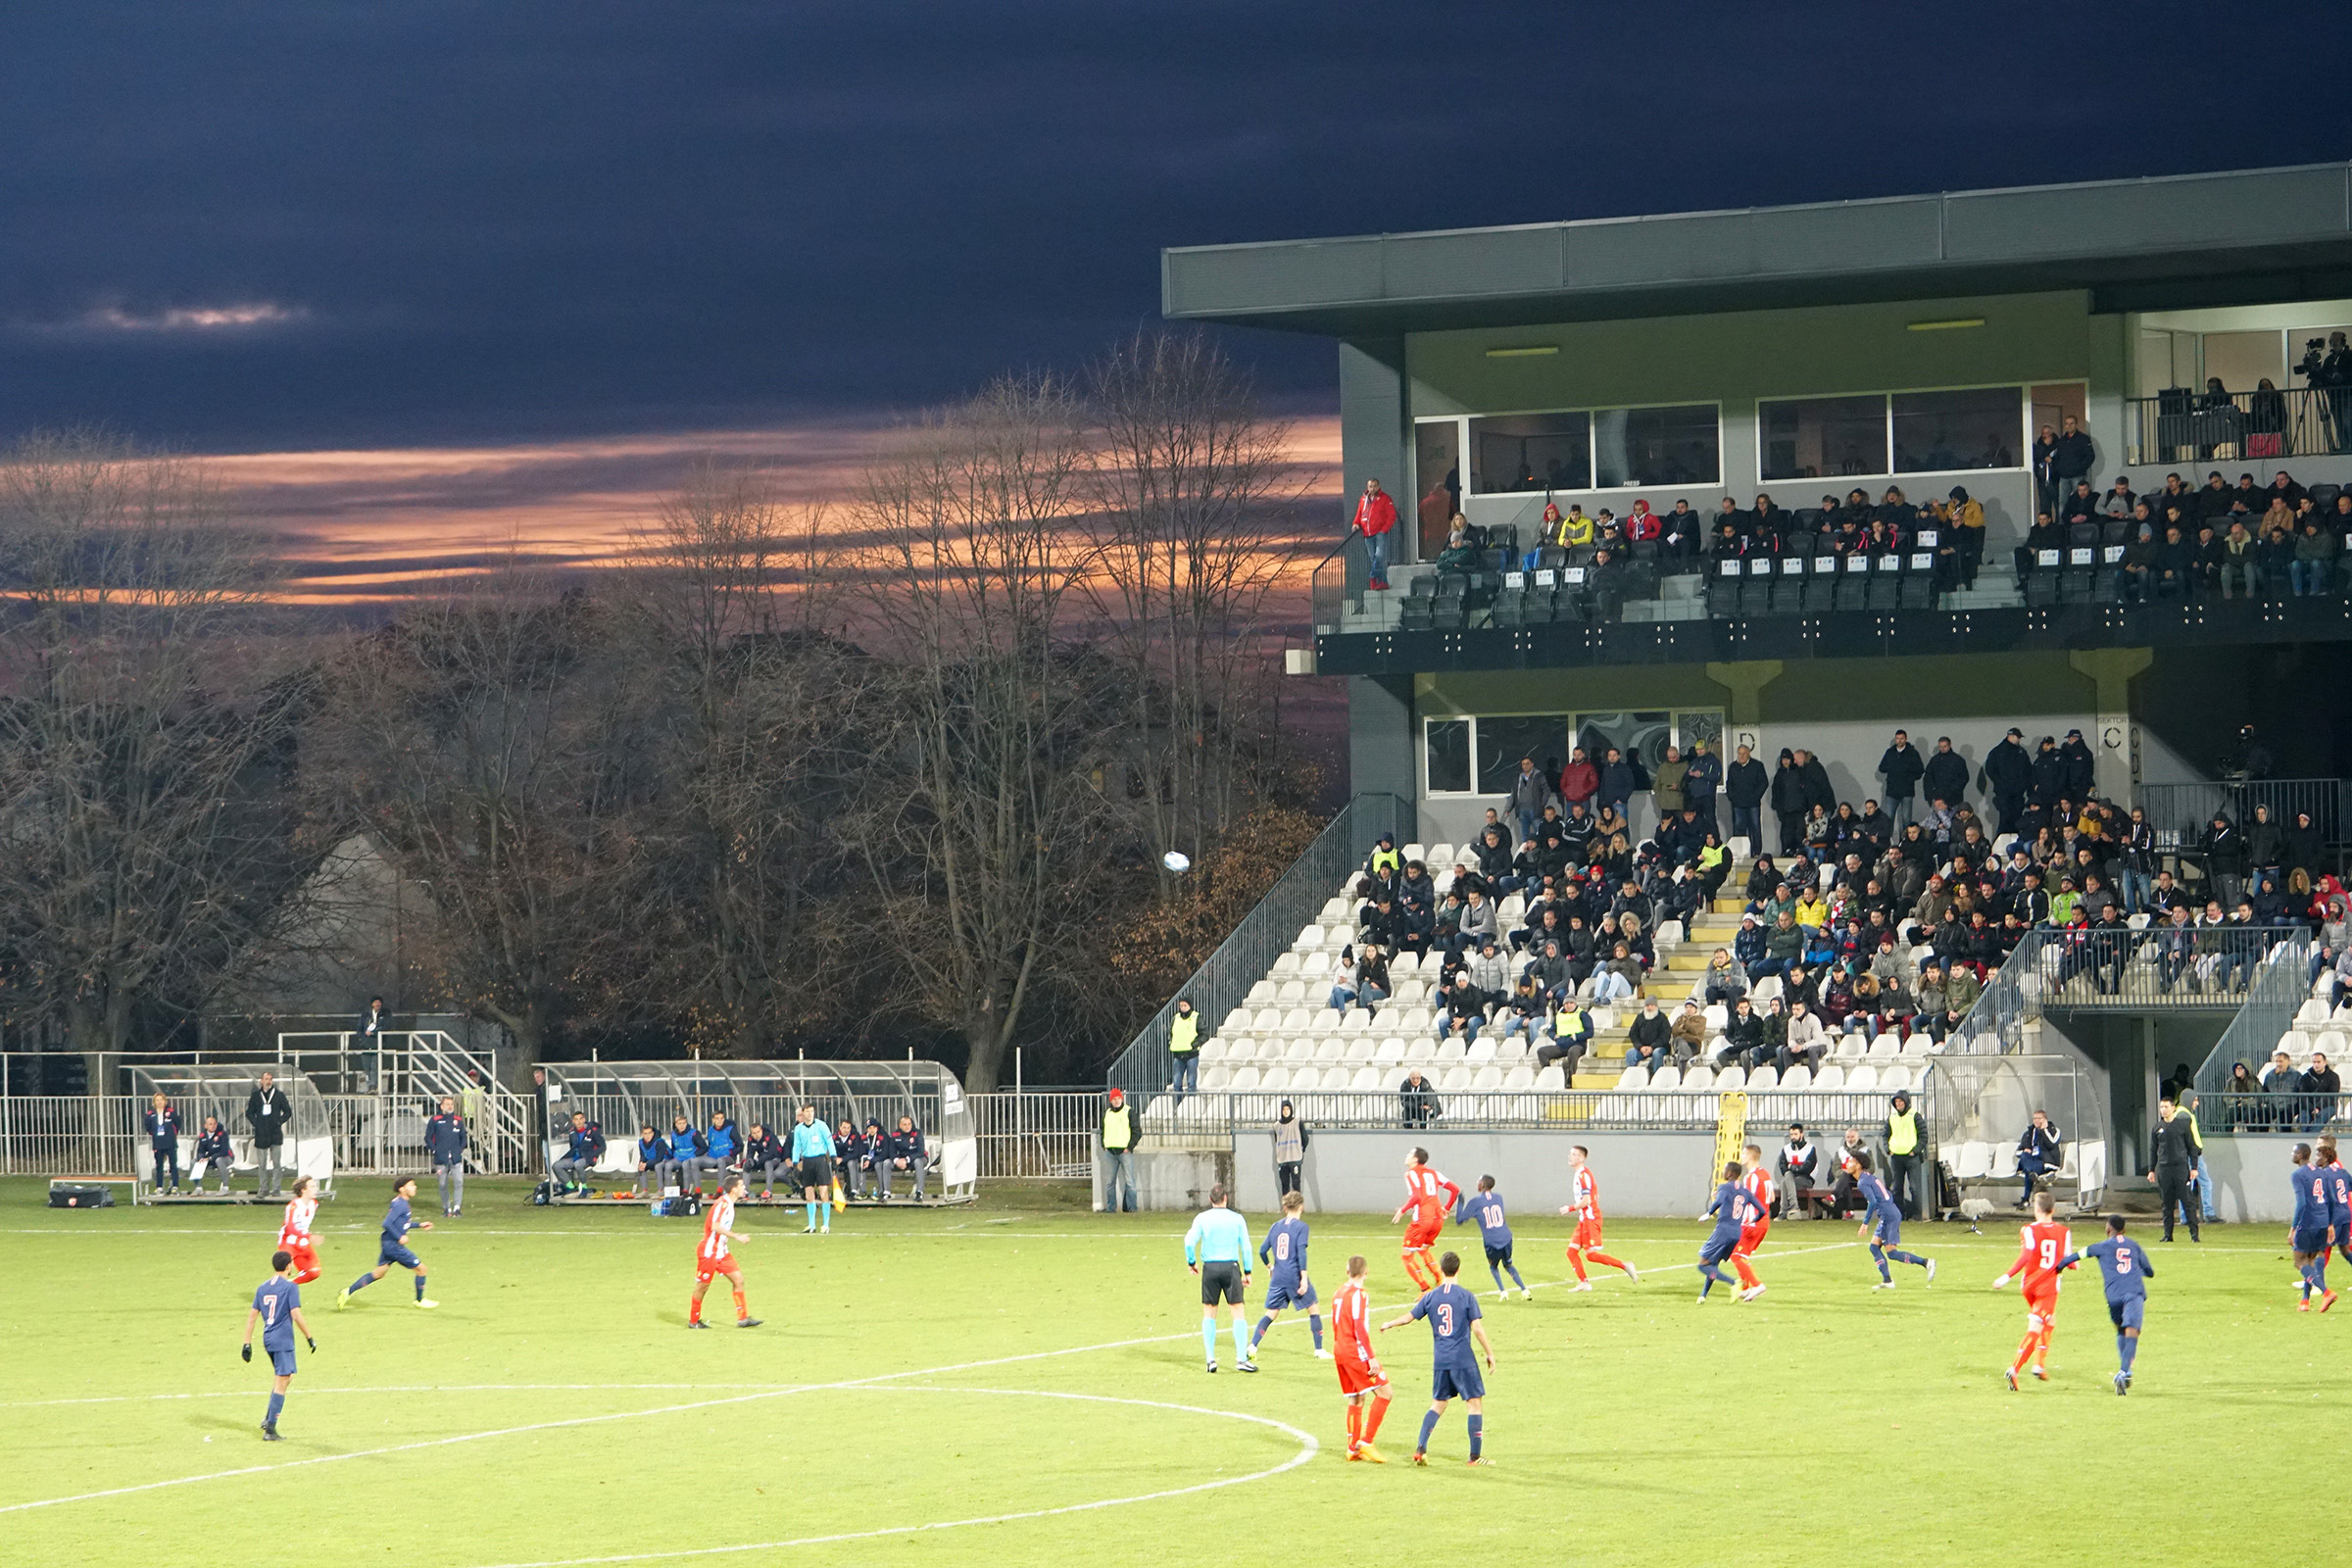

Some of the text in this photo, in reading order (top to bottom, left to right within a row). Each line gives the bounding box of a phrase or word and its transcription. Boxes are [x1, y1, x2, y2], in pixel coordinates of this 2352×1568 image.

[1740, 733, 1755, 752] D
[2104, 727, 2121, 749] C
[2131, 727, 2139, 749] C
[2132, 754, 2139, 774] D
[1422, 1172, 1437, 1196] 8
[2313, 1178, 2325, 1203] 4
[2336, 1179, 2347, 1203] 2
[1483, 1204, 1503, 1228] 10
[1732, 1195, 1744, 1220] 6
[1277, 1232, 1290, 1260] 8
[2039, 1239, 2057, 1269] 9
[2116, 1248, 2132, 1274] 5
[264, 1295, 277, 1324] 7
[1334, 1298, 1343, 1324] 7
[1438, 1303, 1453, 1336] 3
